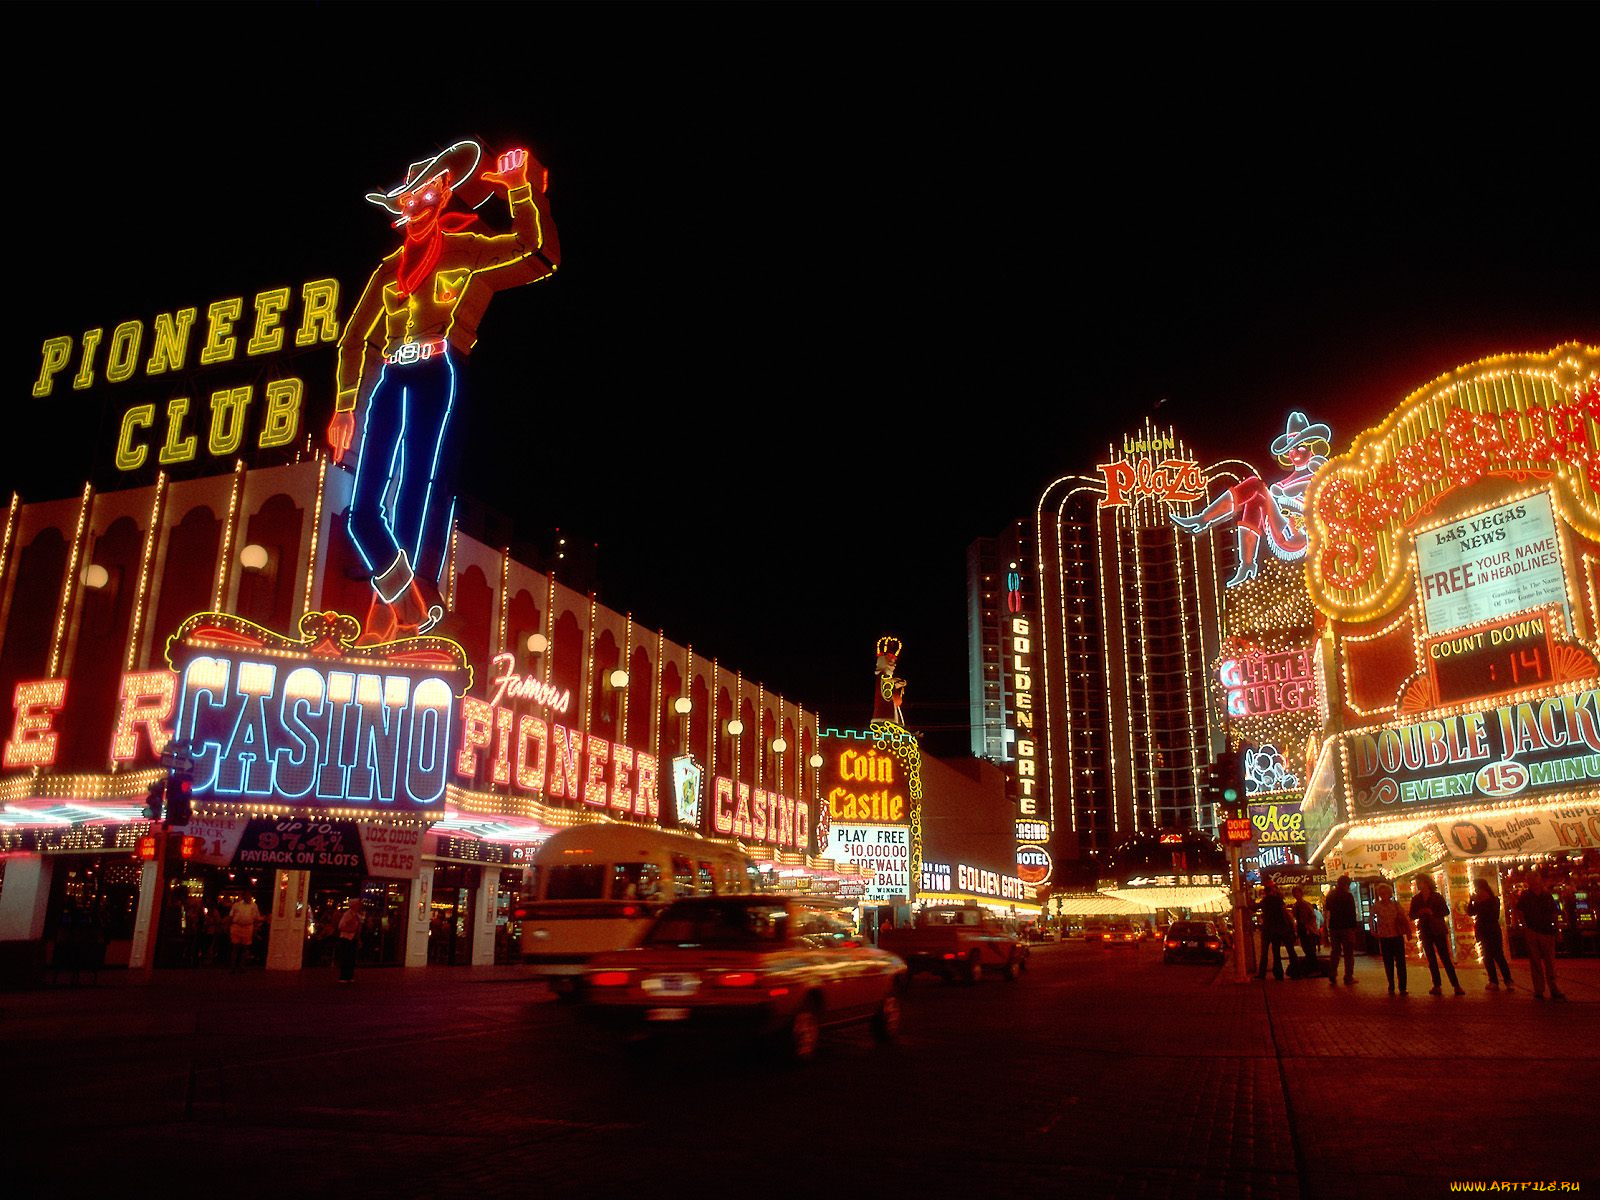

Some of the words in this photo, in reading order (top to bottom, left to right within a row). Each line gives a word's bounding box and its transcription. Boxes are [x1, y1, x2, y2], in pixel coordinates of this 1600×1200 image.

[32, 278, 340, 398] PIONEER
[116, 377, 304, 471] CLUB
[1124, 438, 1174, 454] UNION
[1435, 524, 1467, 546] LAS
[1470, 505, 1527, 534] VEGAS
[1460, 528, 1506, 552] NEWS
[1476, 551, 1511, 570] YOUR
[1515, 538, 1555, 559] NAME
[1477, 572, 1489, 585] IN
[1491, 551, 1558, 582] HEADLINES
[1423, 562, 1476, 600] FREE
[1430, 632, 1485, 659] COUNT
[1490, 618, 1544, 645] DOWN
[490, 652, 570, 713] Famous
[1012, 618, 1033, 729] GOLDEN
[176, 656, 453, 803] CASINO
[1354, 711, 1490, 778] DOUBLE
[456, 696, 660, 817] PIONEER
[840, 749, 894, 783] Coin
[1018, 740, 1036, 814] GATE
[1400, 772, 1477, 802] EVERY
[1484, 766, 1524, 792] 15
[713, 776, 809, 849] CASINO
[829, 787, 904, 821] Castle
[1252, 805, 1302, 831] Ace
[258, 831, 344, 852] 97.4%
[275, 822, 300, 832] UP
[388, 828, 418, 845] ODDS
[838, 829, 867, 842] PLAY
[877, 831, 904, 844] FREE
[1228, 830, 1250, 840] WALK
[1258, 831, 1290, 842] OAN
[1485, 824, 1508, 838] New
[1506, 816, 1541, 833] Orleans
[1498, 827, 1535, 852] Original
[1549, 819, 1593, 848] ICE
[240, 850, 293, 864] PAYBACK
[297, 852, 315, 864] ON
[319, 853, 359, 867] SLOTS
[372, 852, 414, 870] CRAPS
[1366, 844, 1387, 852] HOT
[1388, 843, 1406, 851] DOG
[958, 864, 1000, 896] GOLDEN
[1001, 874, 1024, 900] GATE
